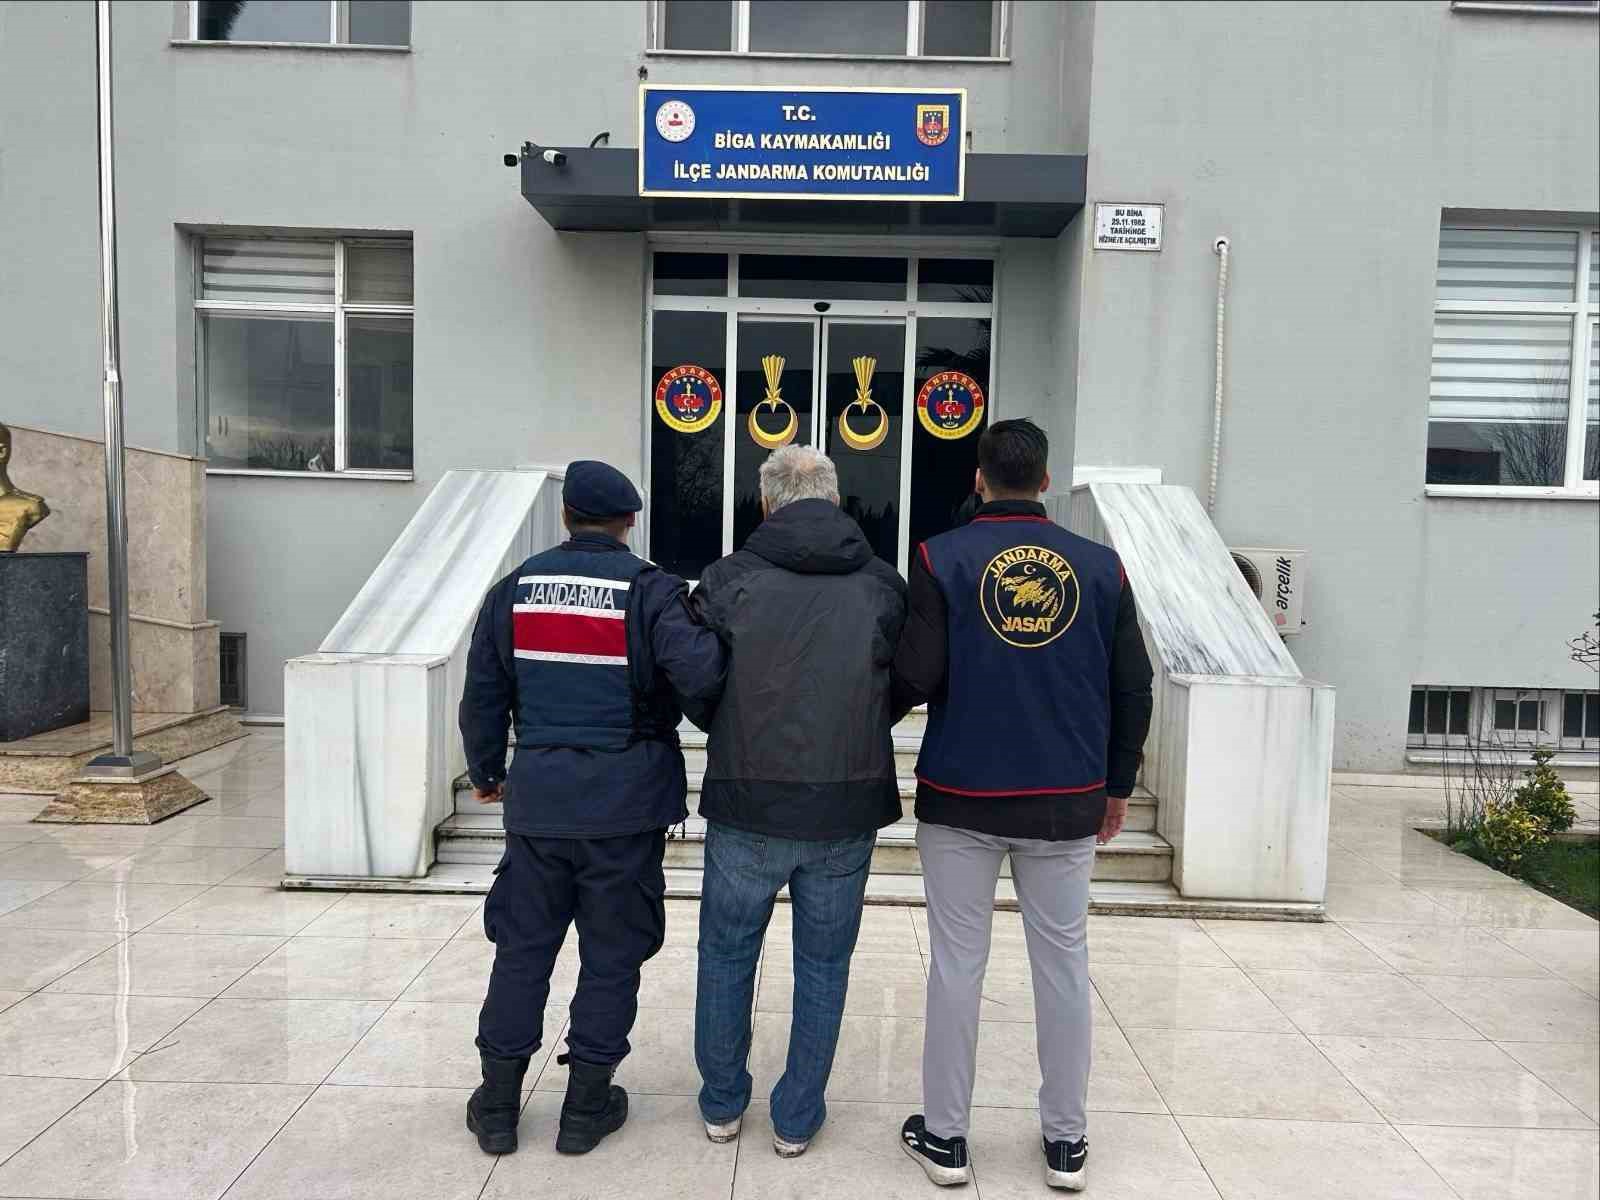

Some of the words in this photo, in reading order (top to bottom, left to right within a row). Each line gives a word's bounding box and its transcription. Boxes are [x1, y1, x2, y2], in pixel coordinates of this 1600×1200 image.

[782, 105, 816, 121] T.C.
[714, 130, 755, 150] BİGA
[760, 131, 890, 151] KAYMAKAMLIĞI
[673, 160, 711, 182] İLÇE
[716, 163, 808, 180] JANDARMA
[813, 162, 929, 182] KOMUTANLIĞI
[1115, 209, 1125, 217] BU
[1126, 208, 1143, 217] BİNA
[659, 367, 718, 393] JANDARMA
[920, 374, 980, 400] JANDARMA
[990, 549, 1071, 582] JANDARMA
[1276, 556, 1292, 610] arçelik
[524, 583, 615, 609] JANDARMA
[1002, 617, 1055, 633] JASAT
